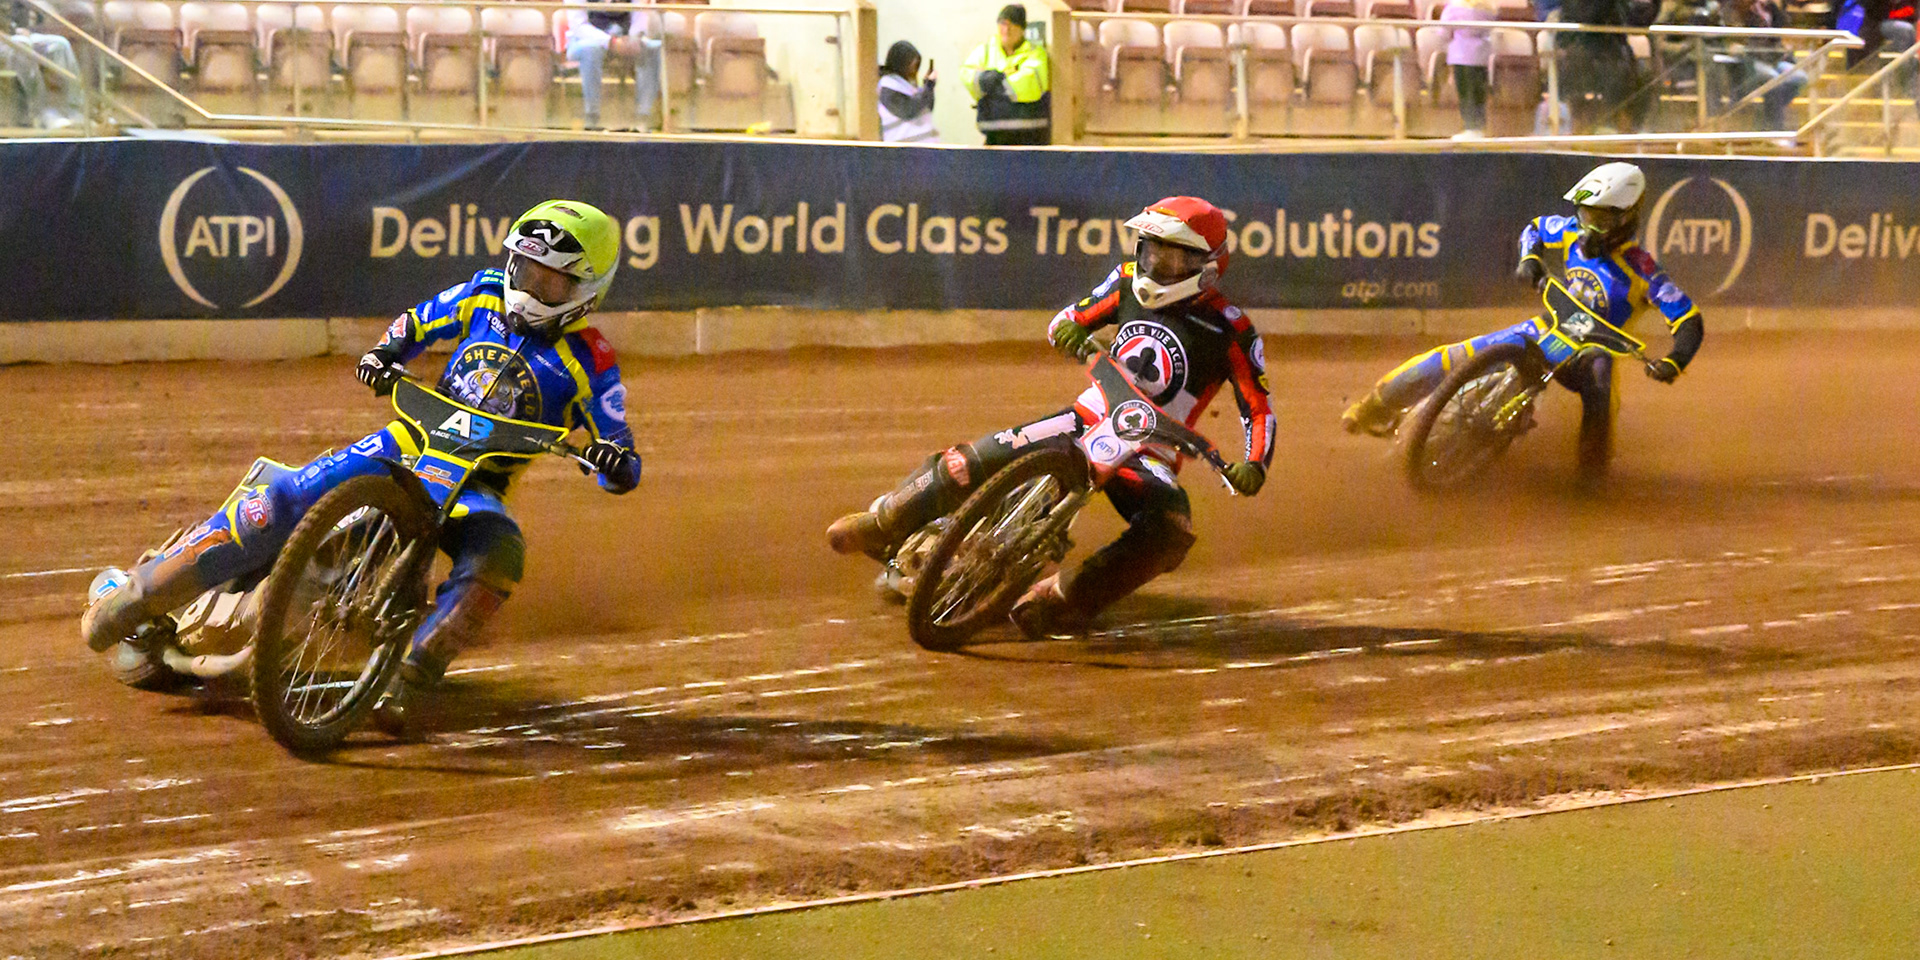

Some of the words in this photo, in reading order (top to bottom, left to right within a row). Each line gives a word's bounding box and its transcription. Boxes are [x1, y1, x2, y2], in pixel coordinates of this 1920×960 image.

[185, 215, 275, 257] ATPI
[370, 203, 660, 270] Delivg
[679, 202, 846, 254] World
[866, 203, 1008, 255] Class
[1029, 206, 1139, 255] Trav
[1662, 218, 1732, 254] ATPI
[1804, 212, 1920, 259] Deliv
[1341, 279, 1439, 303] atpi.com
[1117, 325, 1146, 345] BELLE
[1150, 327, 1171, 345] VUE
[1168, 346, 1184, 375] ACES
[248, 501, 264, 521] STS
